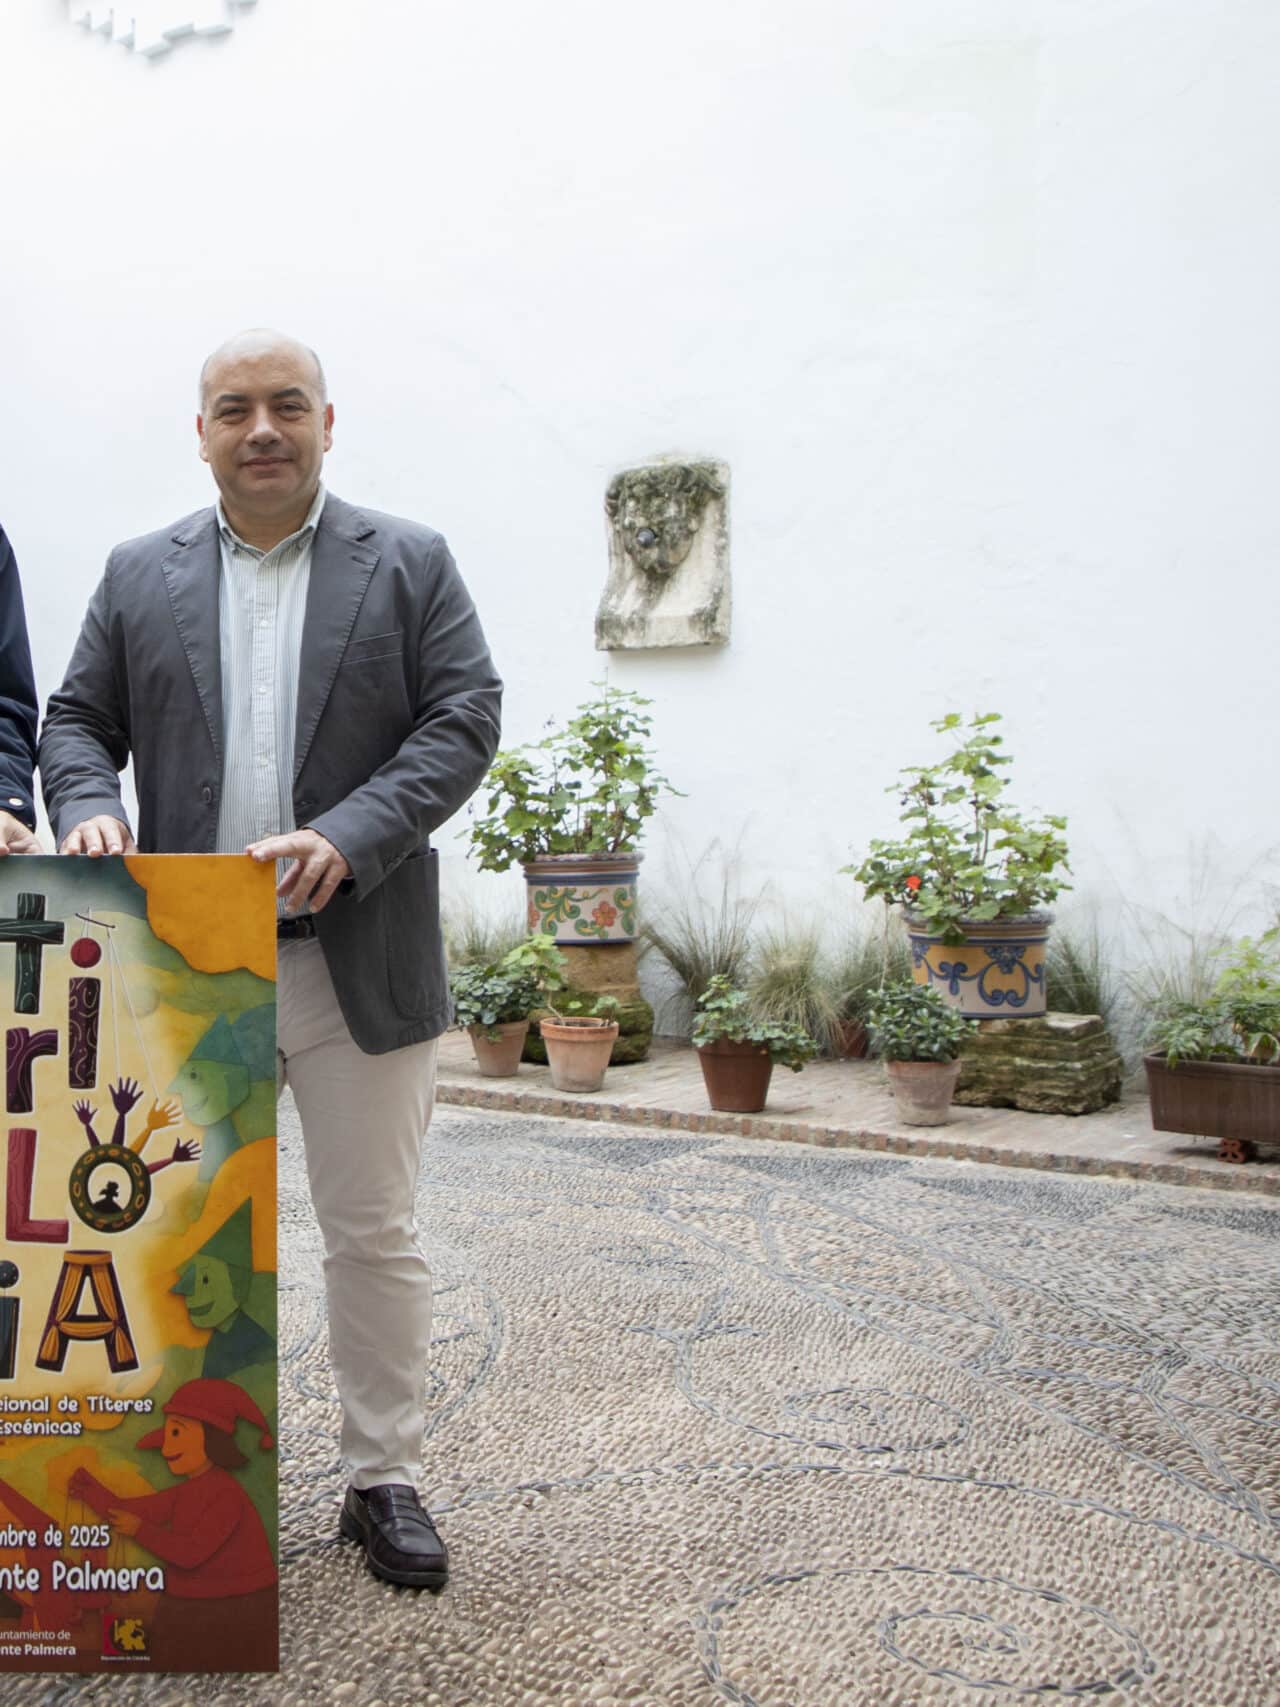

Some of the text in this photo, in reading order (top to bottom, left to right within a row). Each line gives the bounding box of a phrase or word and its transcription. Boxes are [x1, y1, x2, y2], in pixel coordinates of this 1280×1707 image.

[57, 1395, 78, 1412] de
[87, 1395, 153, 1412] Títeres
[44, 1524, 62, 1546] de
[70, 1524, 110, 1546] 2025
[52, 1560, 164, 1590] Palmera
[57, 1629, 71, 1640] de
[24, 1643, 76, 1655] Palmera
